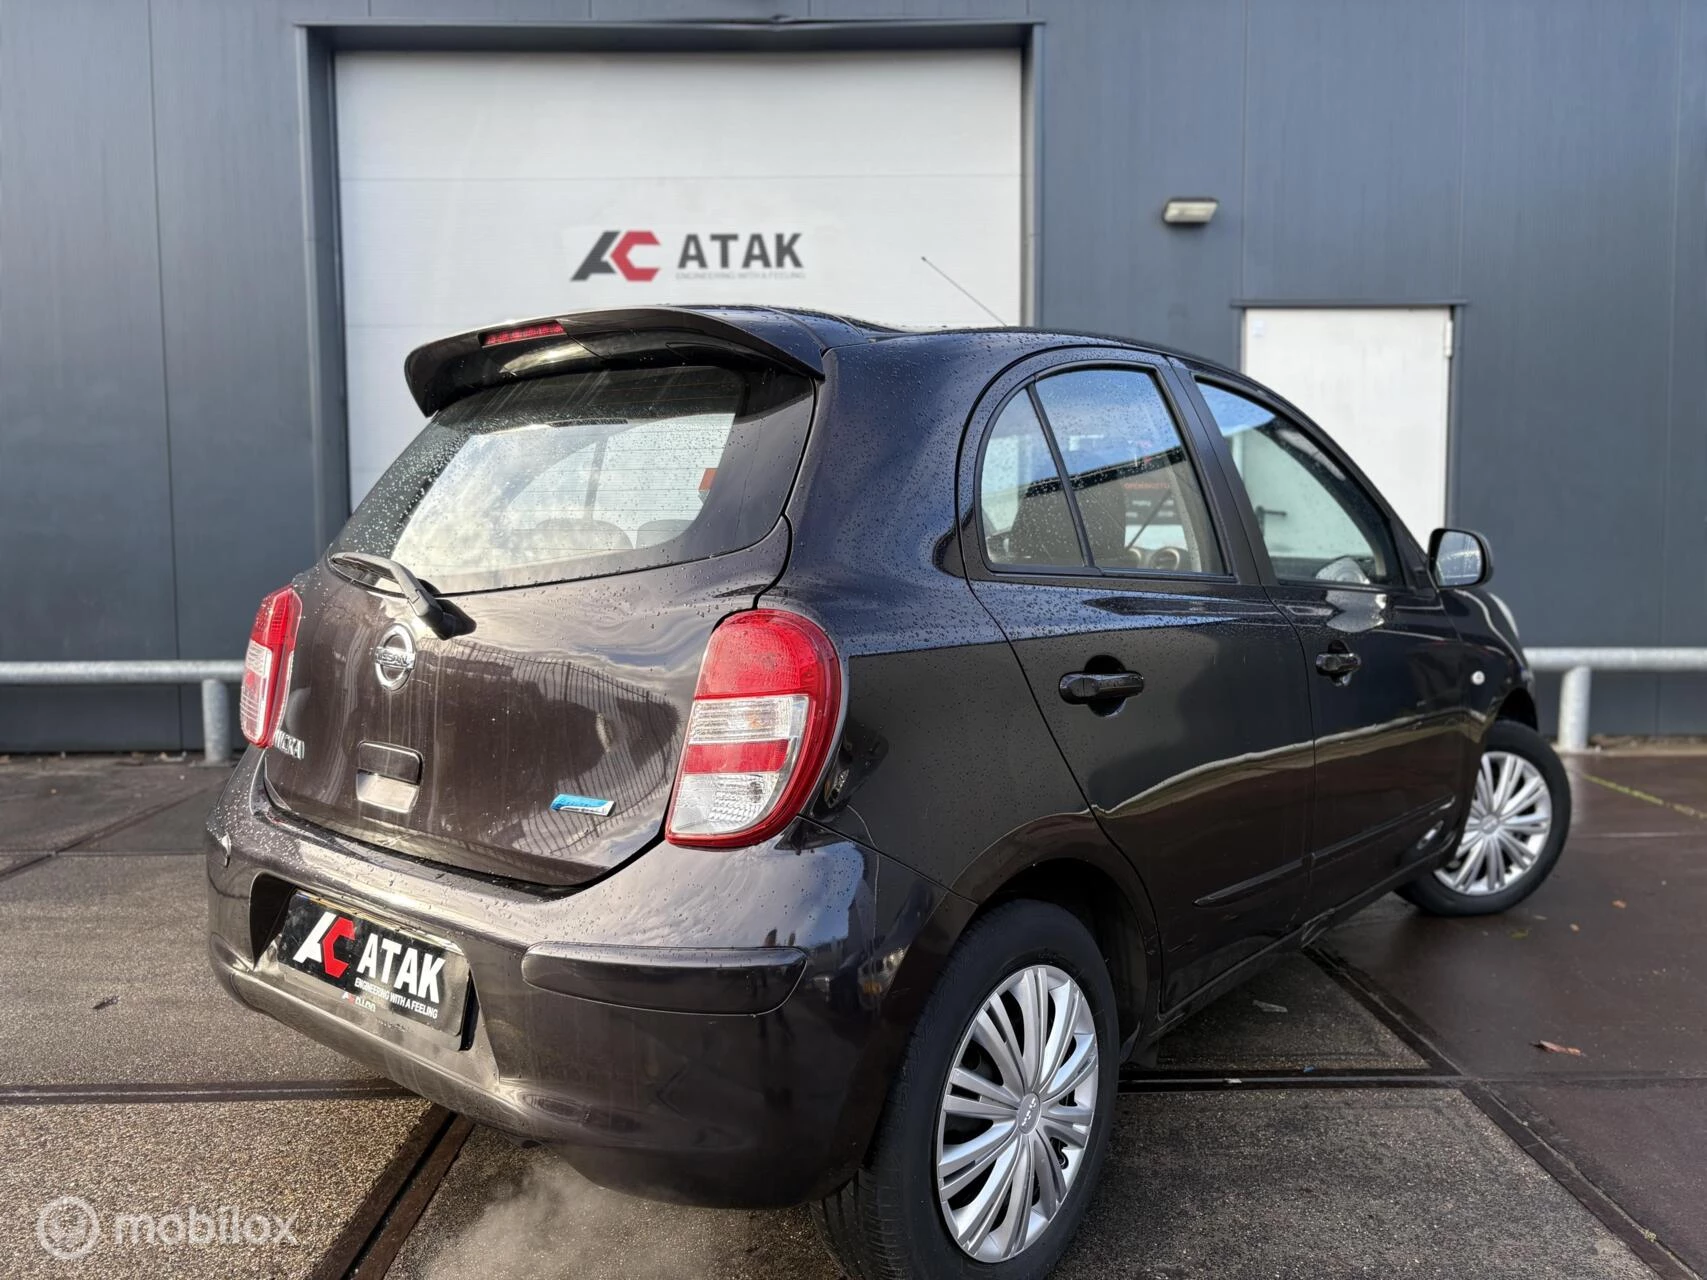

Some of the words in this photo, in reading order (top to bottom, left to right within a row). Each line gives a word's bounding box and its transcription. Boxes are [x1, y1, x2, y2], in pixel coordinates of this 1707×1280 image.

[677, 233, 804, 269] ATAK
[356, 933, 446, 1004] ATAK
[354, 977, 390, 1000] ENGINEERING
[389, 991, 406, 1007] WITH
[410, 1000, 438, 1019] FEELING
